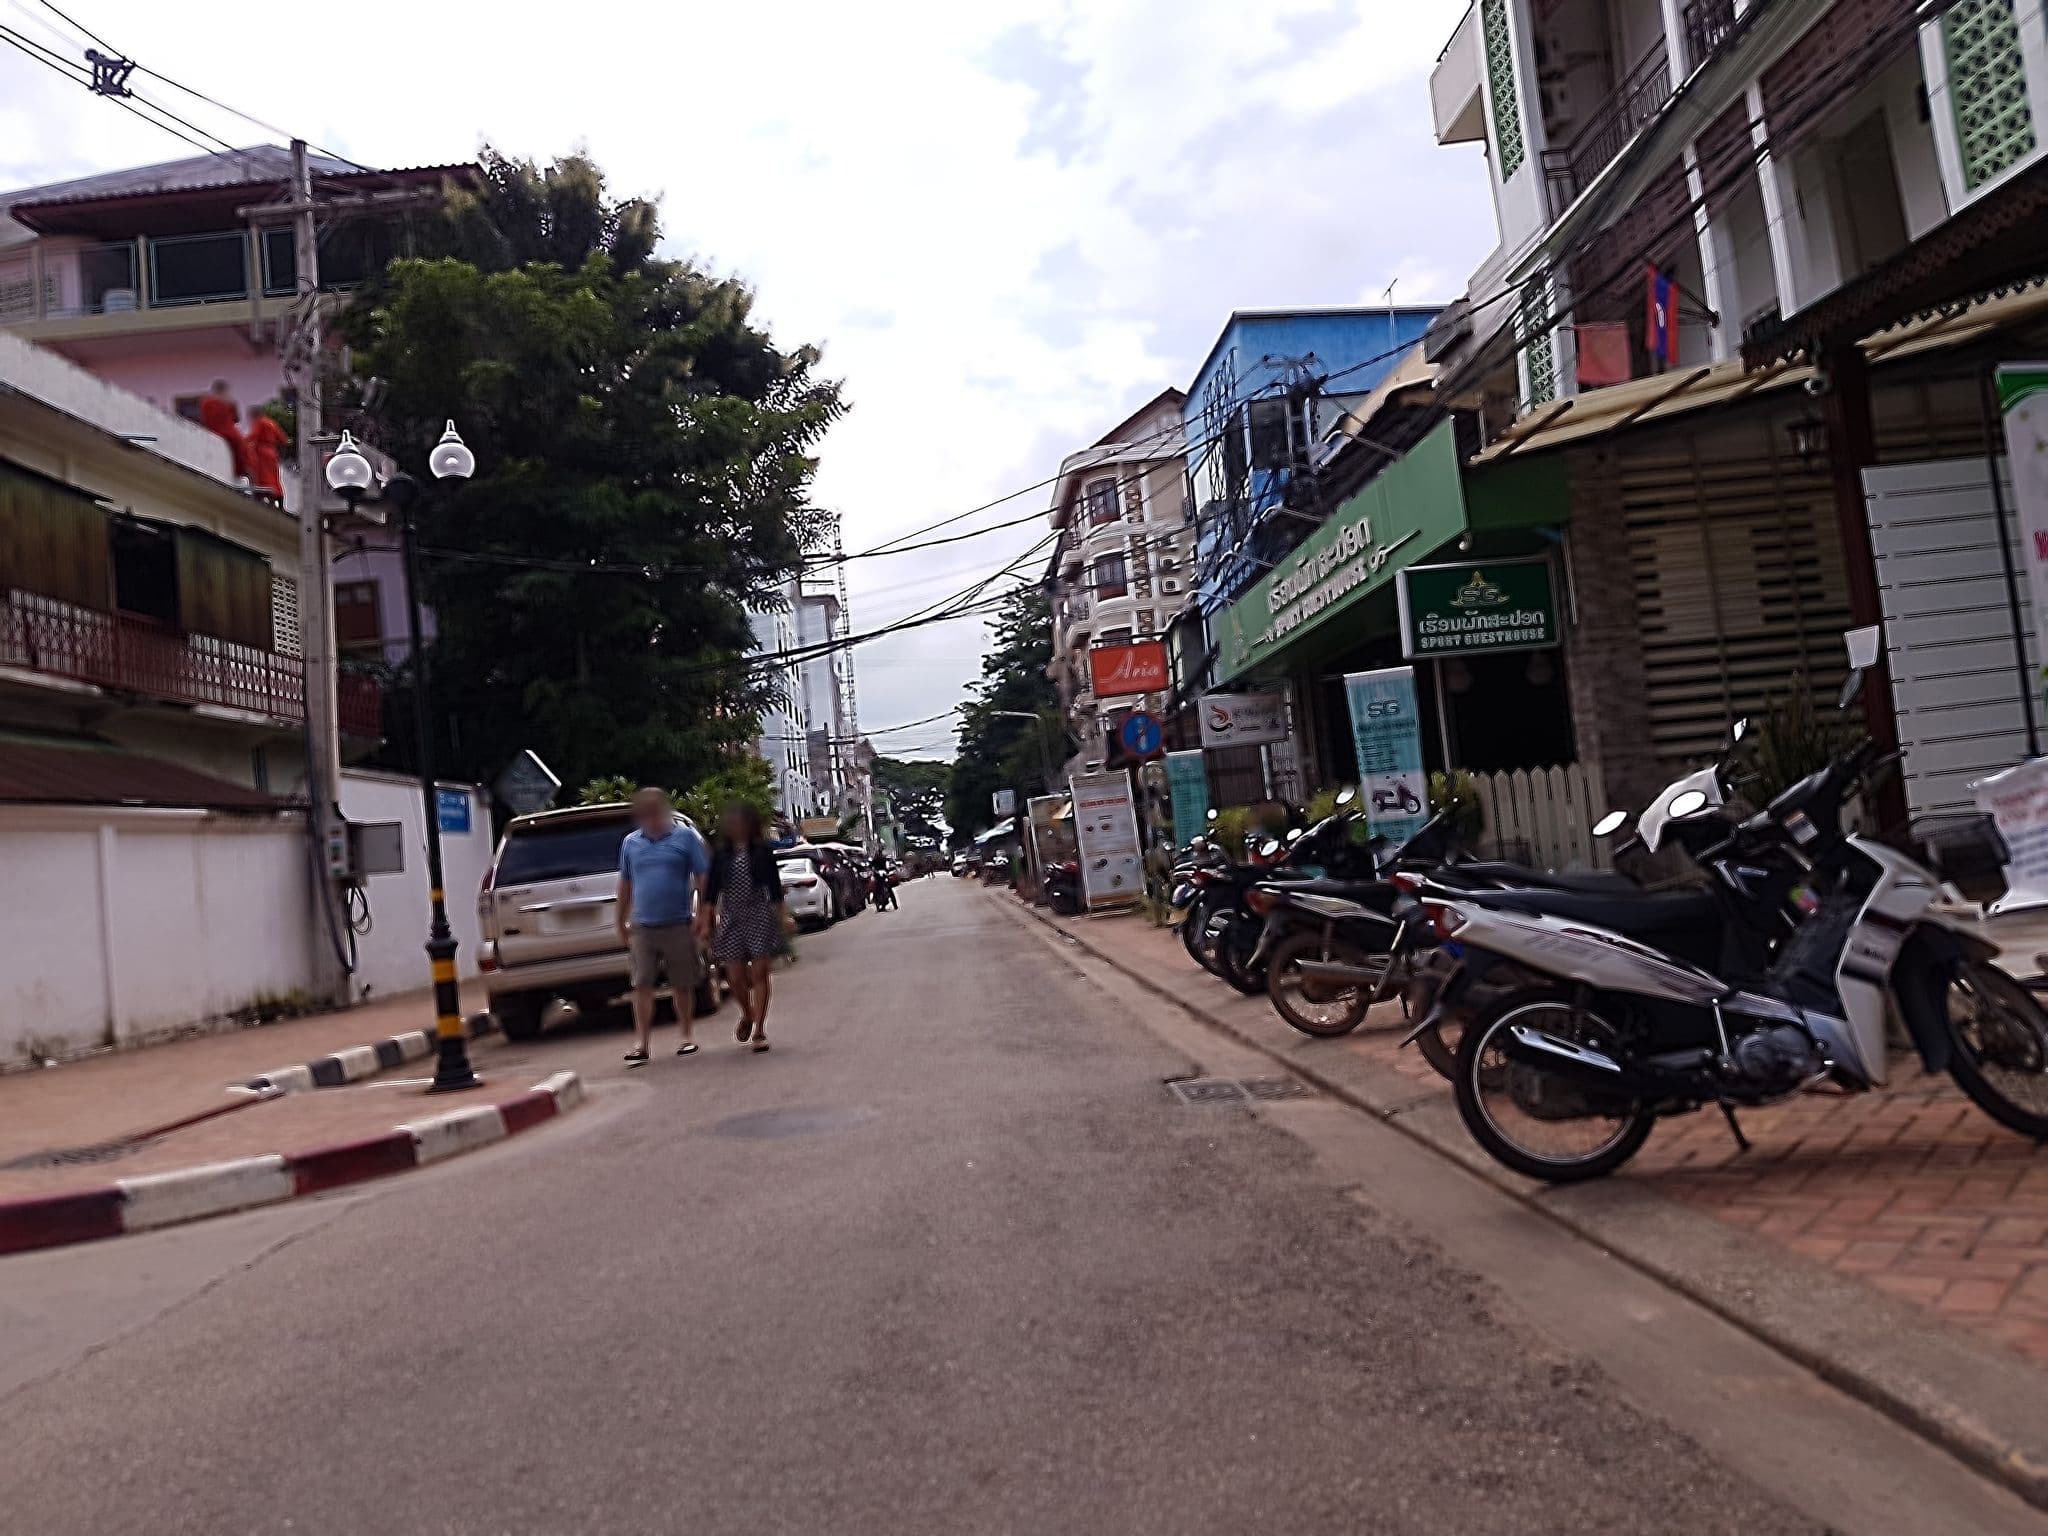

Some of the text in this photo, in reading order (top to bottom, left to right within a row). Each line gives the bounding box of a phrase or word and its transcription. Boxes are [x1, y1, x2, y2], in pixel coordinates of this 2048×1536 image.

[1420, 627, 1545, 649] SPORT GUESTHOUSE
[1367, 699, 1400, 718] SG
